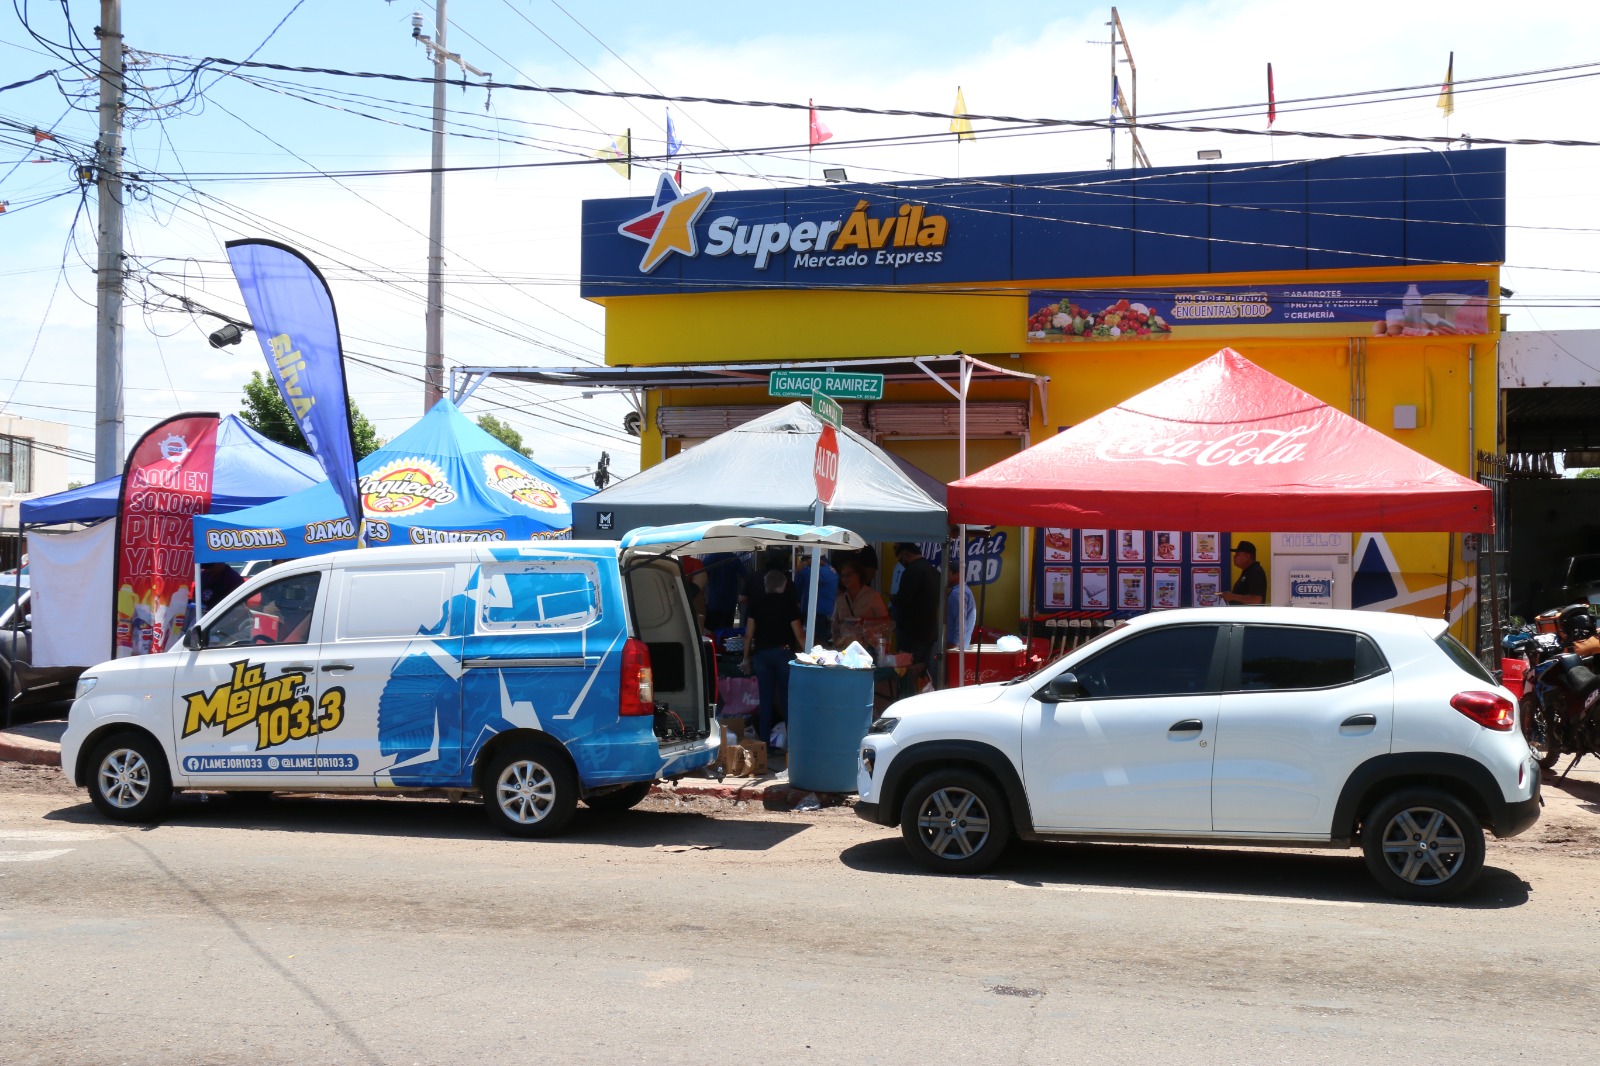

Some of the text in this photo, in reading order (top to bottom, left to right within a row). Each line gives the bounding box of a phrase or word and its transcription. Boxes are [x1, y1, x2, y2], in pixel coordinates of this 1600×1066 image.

[794, 250, 943, 269] Mercado Express
[1176, 293, 1268, 304] UN SUPER DONDE
[1290, 290, 1342, 298] ABARROTES
[1176, 304, 1266, 317] ENCUENTRAS TODO
[1290, 309, 1336, 319] CREMERÍA
[825, 378, 878, 392] RAMIREZ
[1097, 423, 1322, 467] Coca-Cola
[815, 446, 837, 482] ALTO
[132, 464, 208, 492] AQUÍ EN
[129, 491, 204, 516] SONORA
[125, 514, 194, 548] PURA
[208, 528, 286, 550] BOLONIA
[305, 518, 391, 543] JAMOES
[410, 527, 506, 545] CHORIZOS
[125, 548, 194, 577] YAQUI
[230, 660, 265, 691] la
[182, 673, 310, 739] Mejor FM
[256, 687, 345, 751] 103.3
[281, 757, 354, 769] @LAMEJOR103.3
